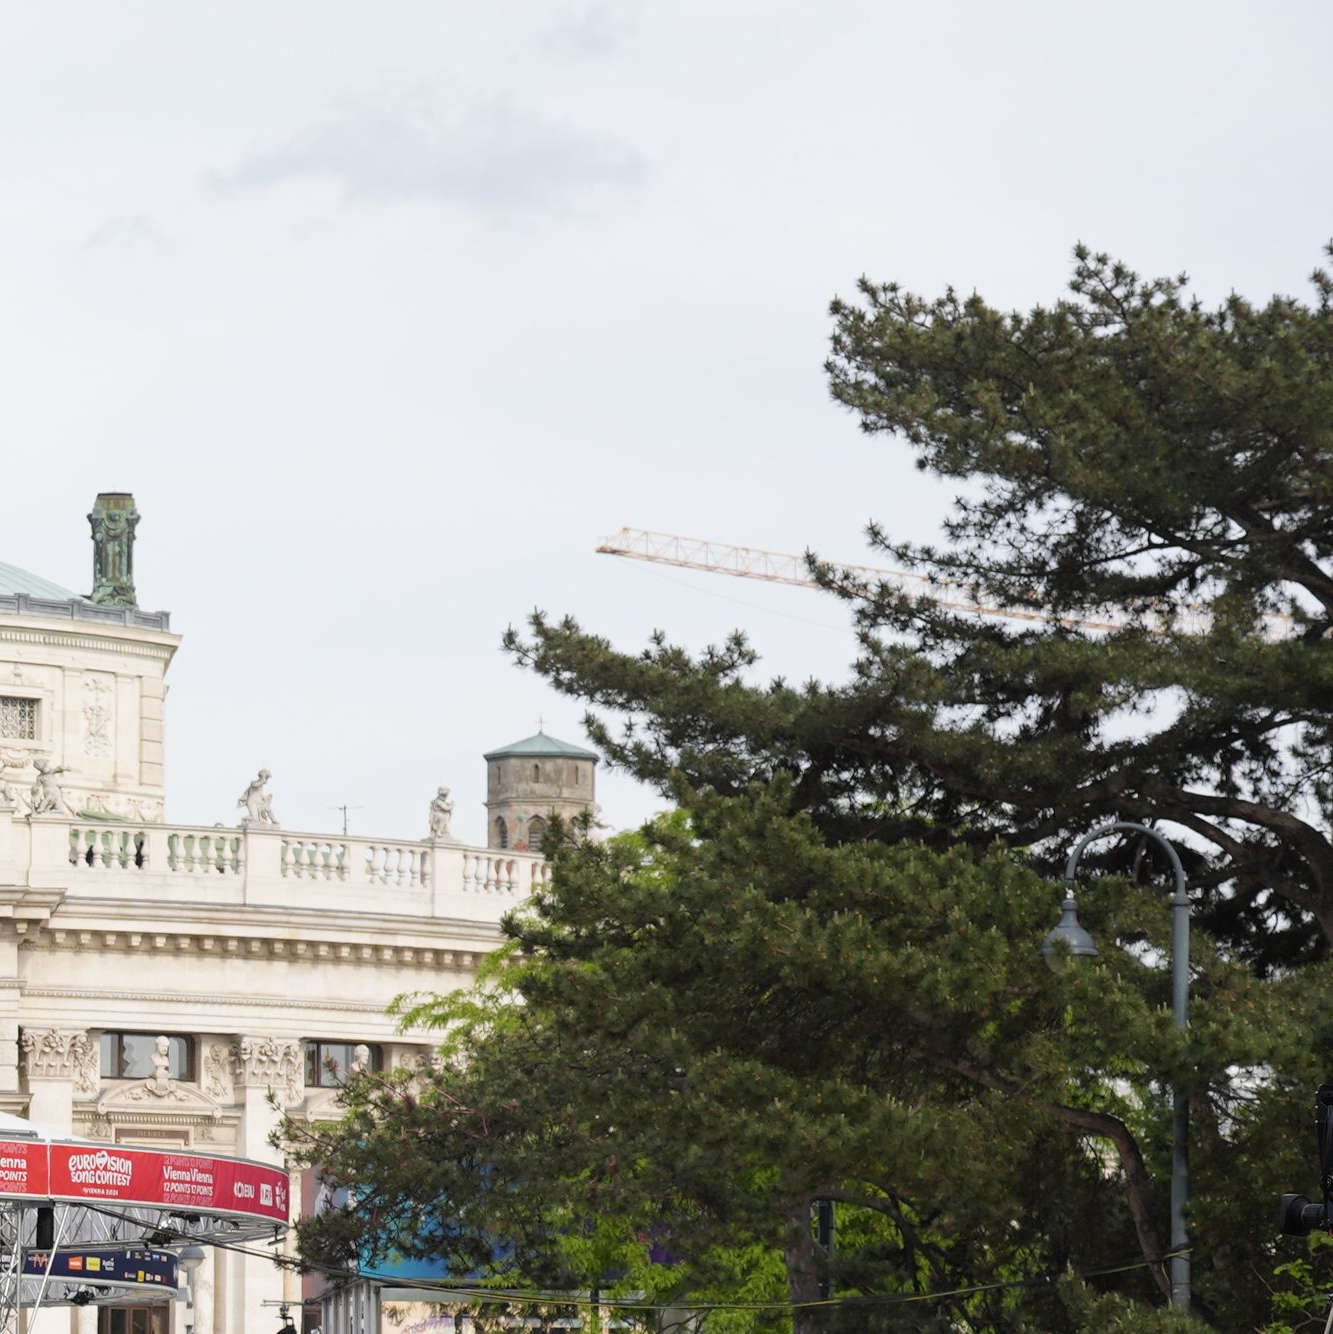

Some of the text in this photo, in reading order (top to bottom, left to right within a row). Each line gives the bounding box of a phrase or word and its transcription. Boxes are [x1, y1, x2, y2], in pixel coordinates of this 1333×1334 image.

[68, 1150, 133, 1175] EUROVISION
[70, 1171, 132, 1187] SONG CONTEST
[163, 1165, 213, 1184] Vienna Vienna
[83, 1186, 105, 1196] VIENNA
